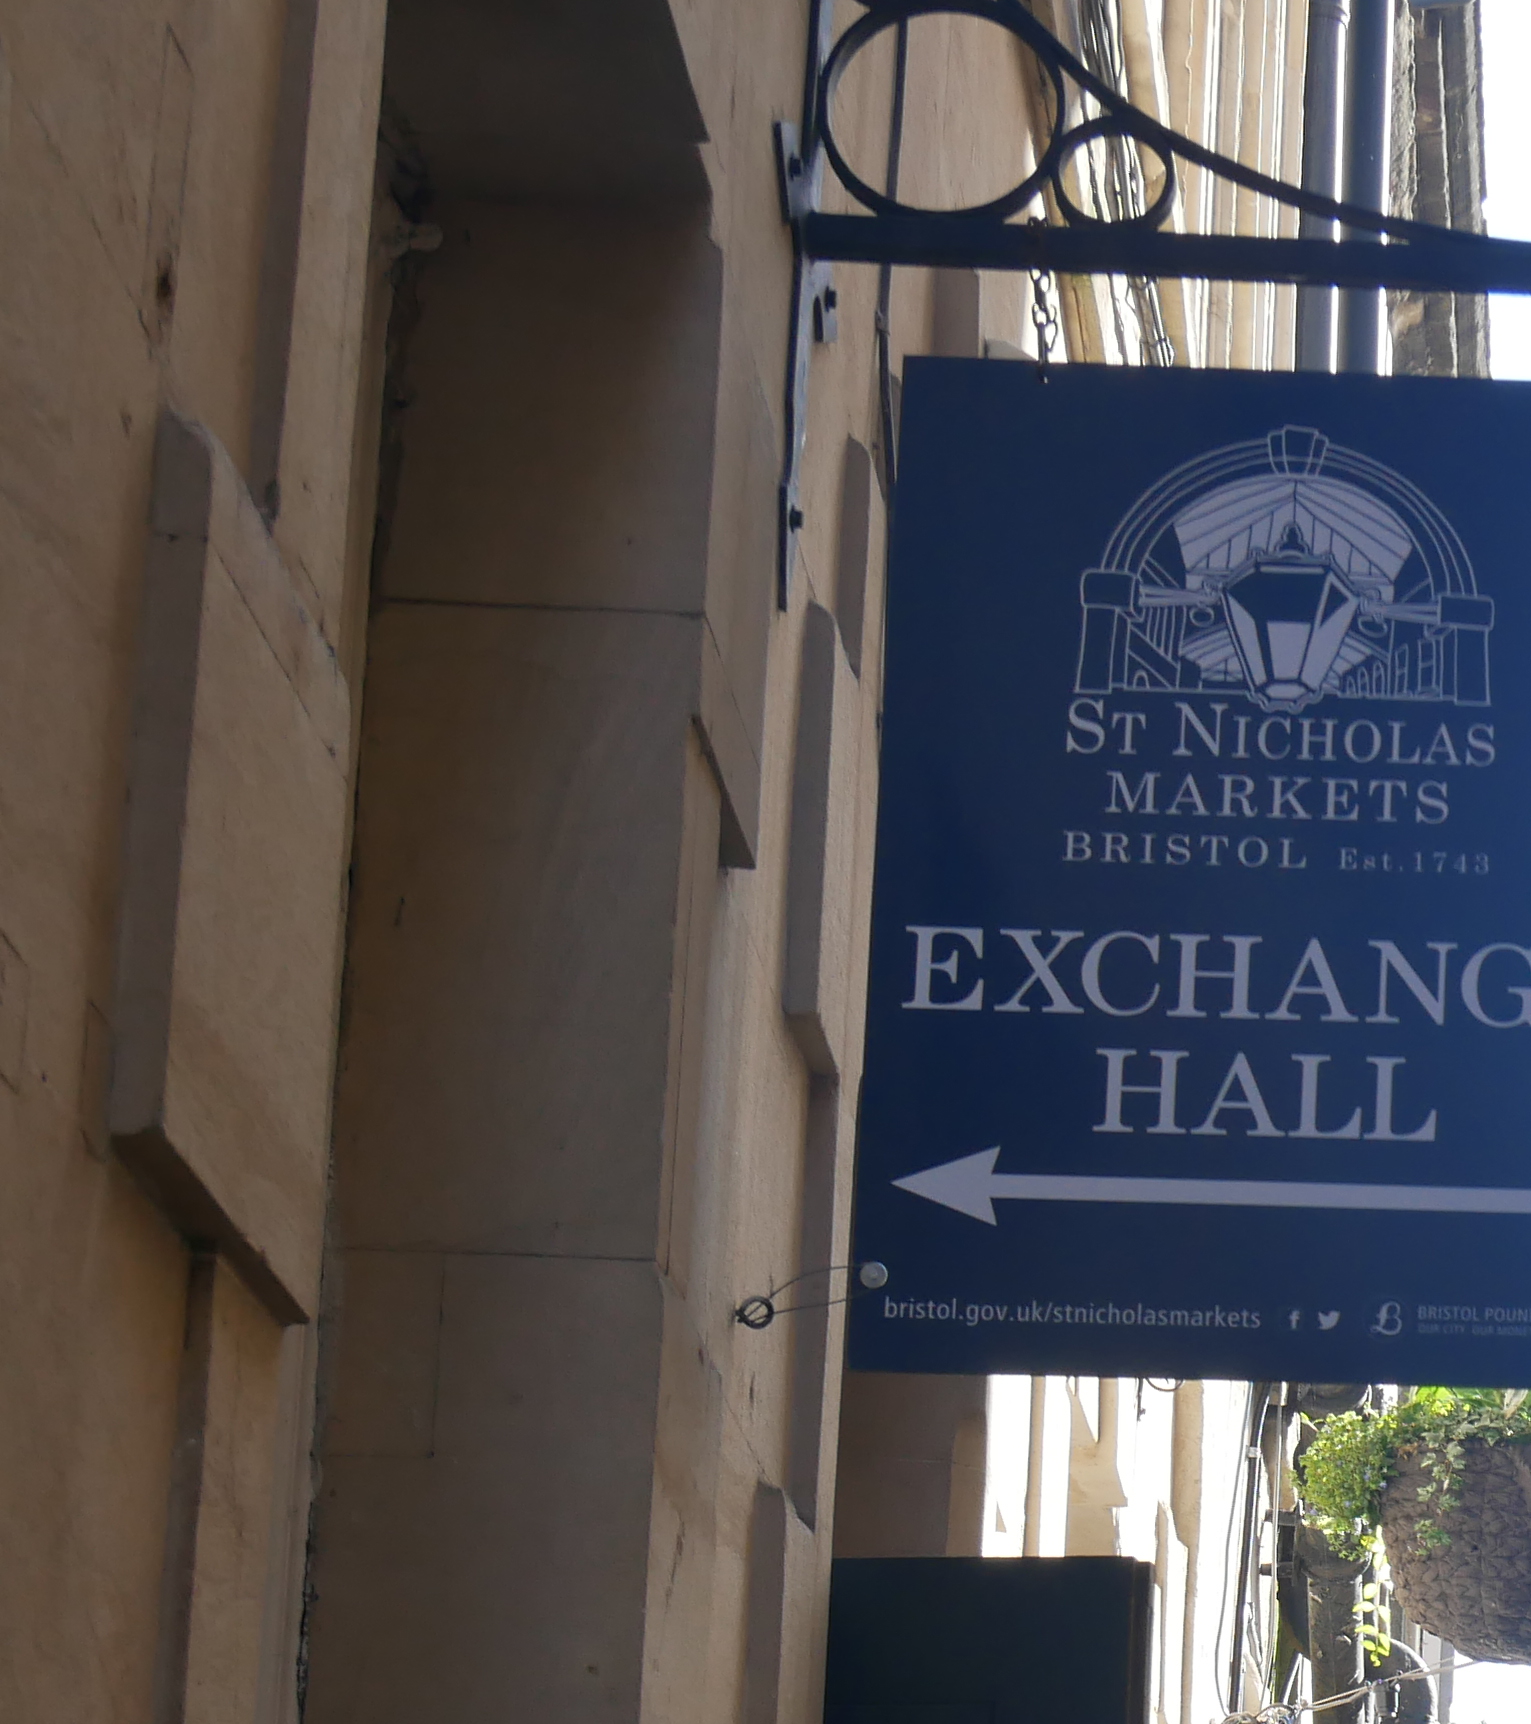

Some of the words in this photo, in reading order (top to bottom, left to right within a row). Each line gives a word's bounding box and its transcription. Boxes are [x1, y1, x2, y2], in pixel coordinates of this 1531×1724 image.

[1065, 698, 1145, 757] ST
[1172, 703, 1496, 767] NICHOLAS
[1105, 771, 1449, 825] MARKETS
[1061, 831, 1307, 870] BRISTOL
[1093, 1048, 1438, 1142] HALL
[883, 1295, 1261, 1331] bristol.gov.uk/stnicholasmarkets
[1416, 1304, 1480, 1322] BRISTOL
